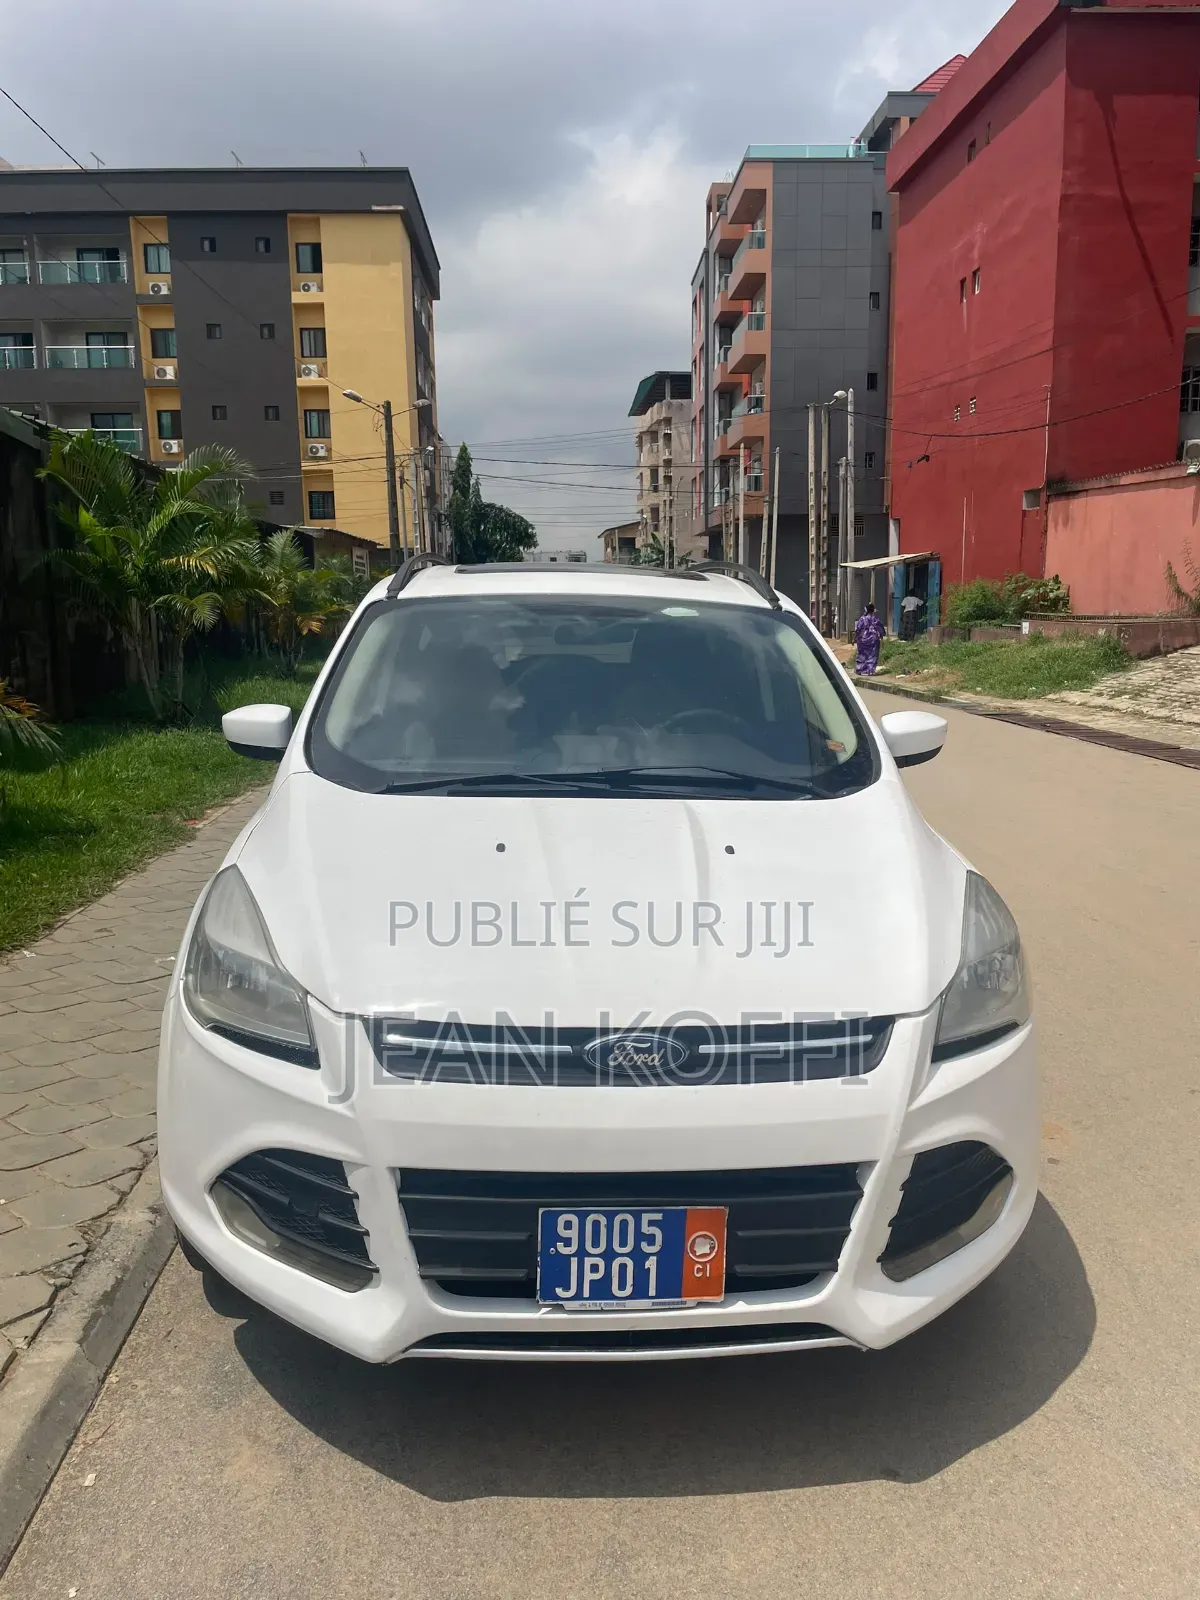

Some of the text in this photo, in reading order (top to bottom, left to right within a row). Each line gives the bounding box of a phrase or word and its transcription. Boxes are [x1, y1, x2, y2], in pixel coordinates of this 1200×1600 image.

[607, 1041, 665, 1066] Ford
[556, 1213, 664, 1255] 9005
[555, 1256, 658, 1298] JP01
[693, 1264, 710, 1278] CI
